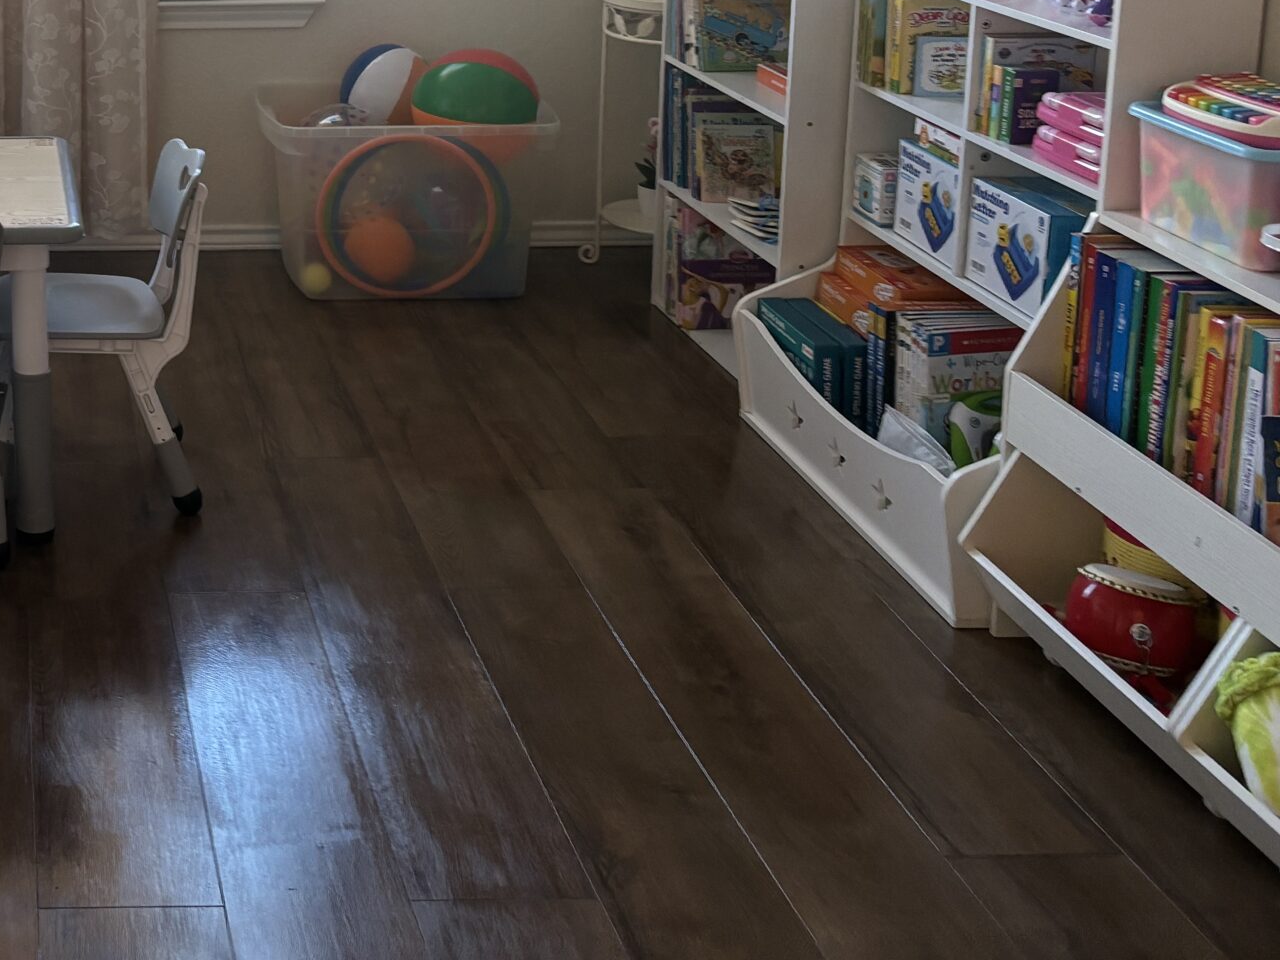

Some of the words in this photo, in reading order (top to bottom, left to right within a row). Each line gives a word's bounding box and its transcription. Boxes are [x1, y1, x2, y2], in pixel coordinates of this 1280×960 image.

[901, 146, 932, 174] Matching
[973, 183, 1010, 215] Matching
[932, 335, 946, 351] P
[1203, 362, 1217, 404] Reading
[1201, 409, 1212, 437] Street
